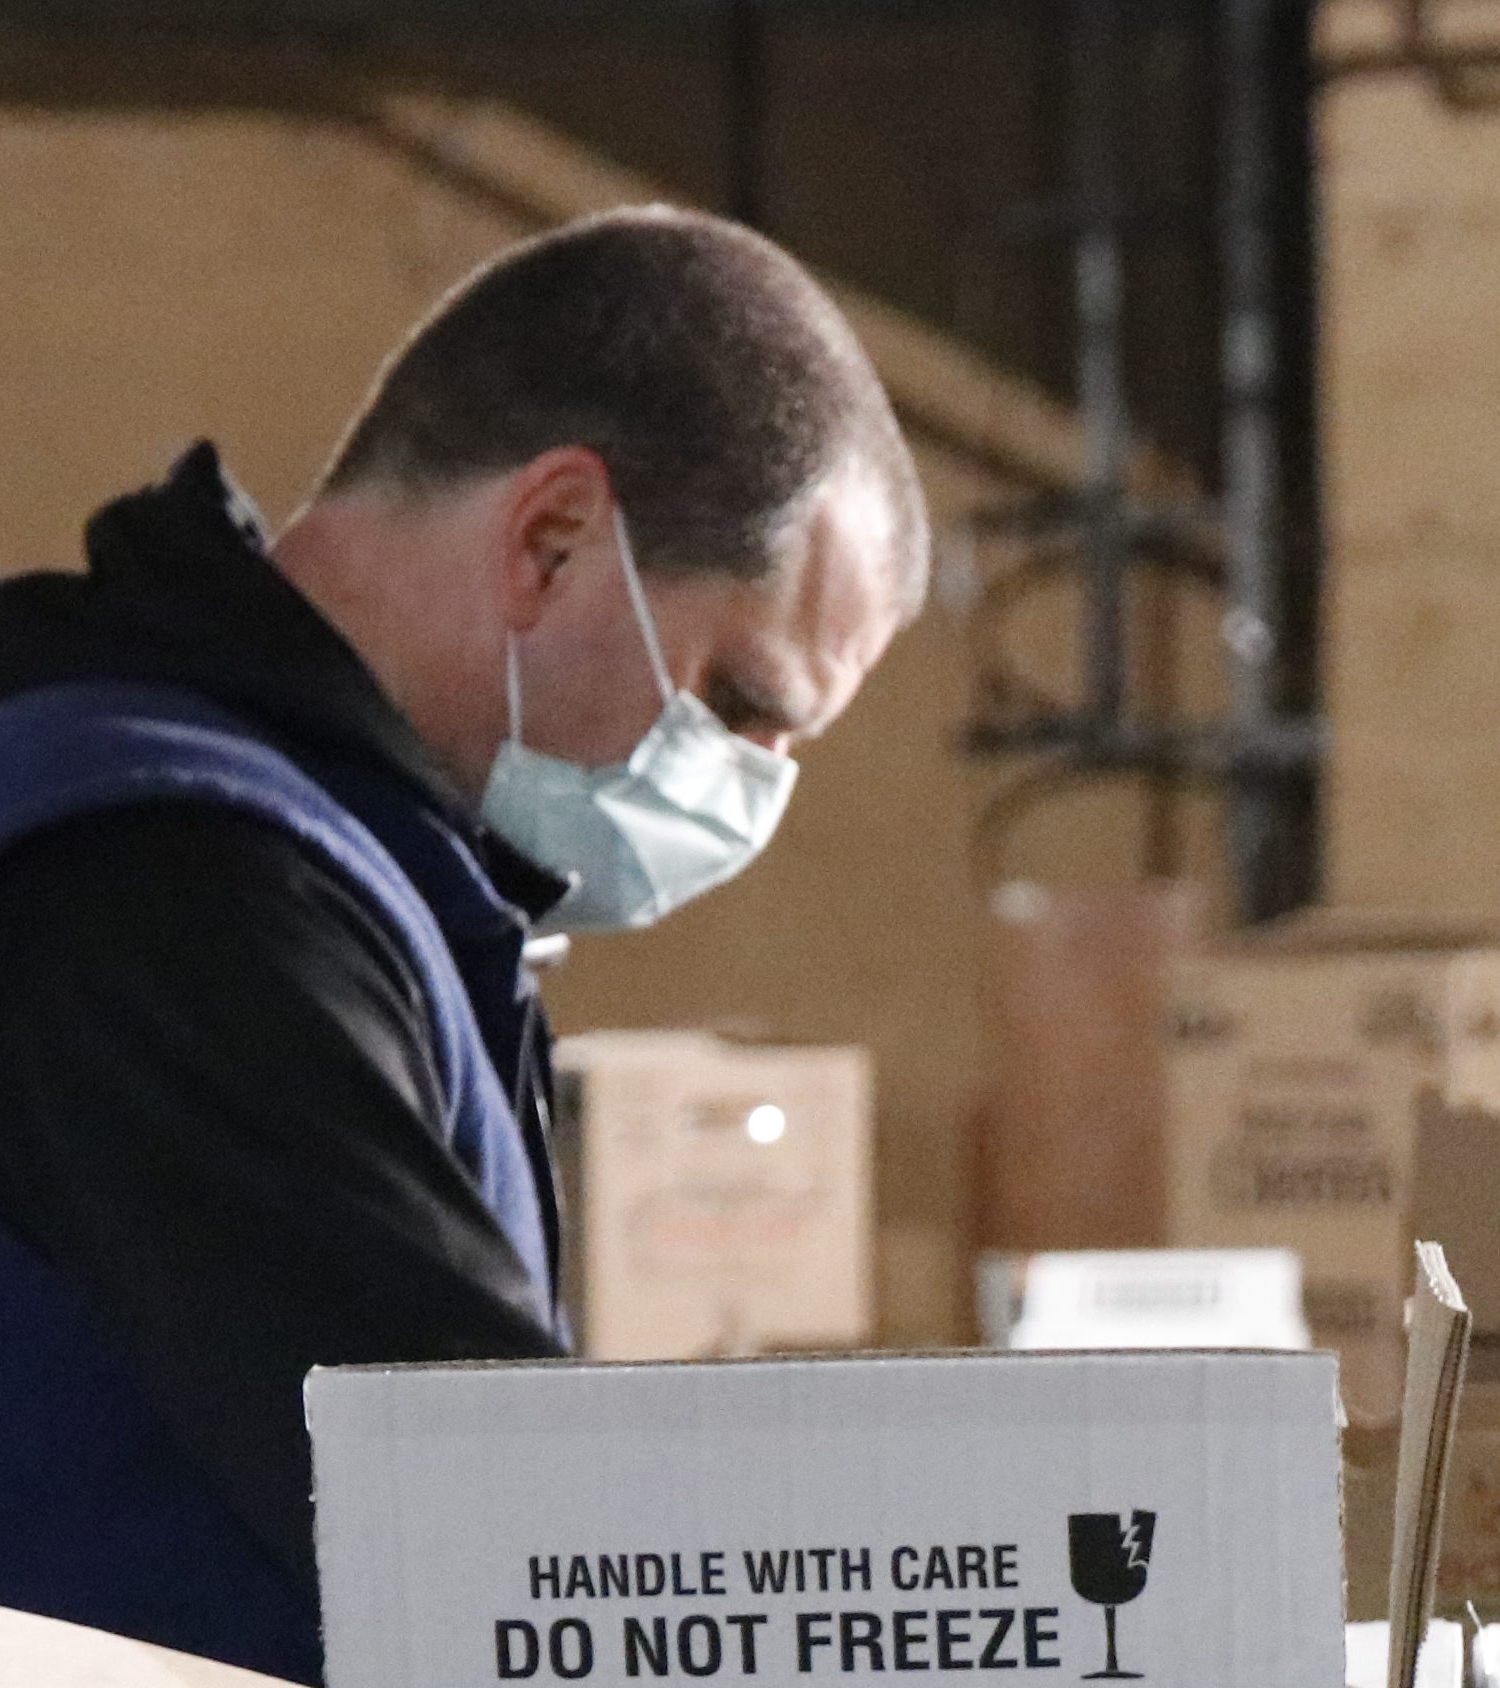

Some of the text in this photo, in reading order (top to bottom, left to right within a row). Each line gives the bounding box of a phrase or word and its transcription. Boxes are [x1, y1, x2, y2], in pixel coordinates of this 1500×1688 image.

[528, 1544, 1018, 1599] HANDLE WITH CARE
[495, 1608, 1061, 1680] DO NOT FREEZE
